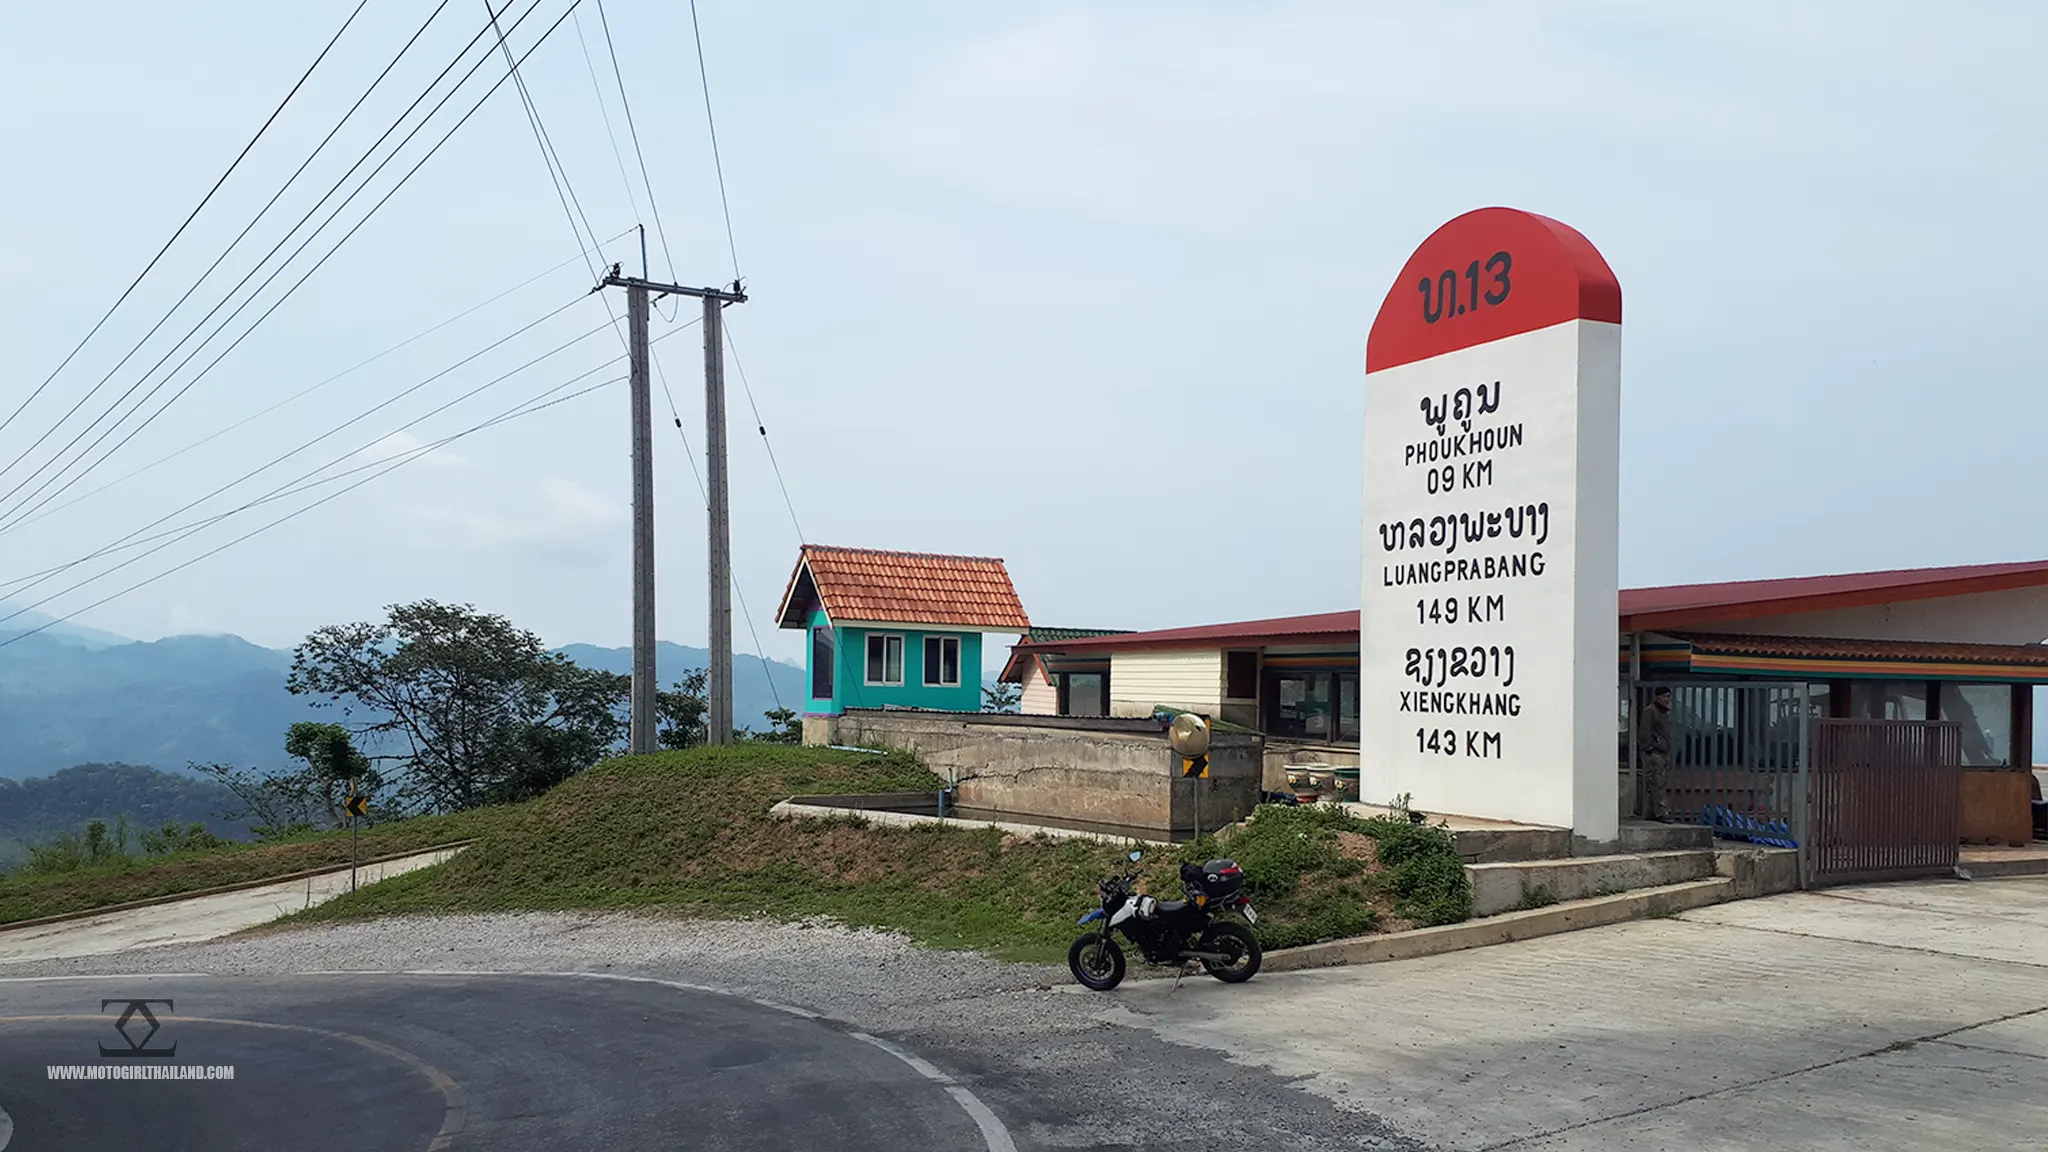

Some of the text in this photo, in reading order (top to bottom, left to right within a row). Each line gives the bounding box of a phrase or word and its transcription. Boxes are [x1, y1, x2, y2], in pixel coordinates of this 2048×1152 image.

[1420, 381, 1501, 437] ພູຄູນ
[1405, 422, 1523, 467] PHOUKHOUN
[1427, 459, 1493, 495] 09 KM
[1383, 551, 1546, 587] LUANGPRABANG
[1416, 594, 1504, 625] 149 KM
[1399, 690, 1522, 717] XIENGKHANG
[1416, 727, 1502, 759] 143 KM
